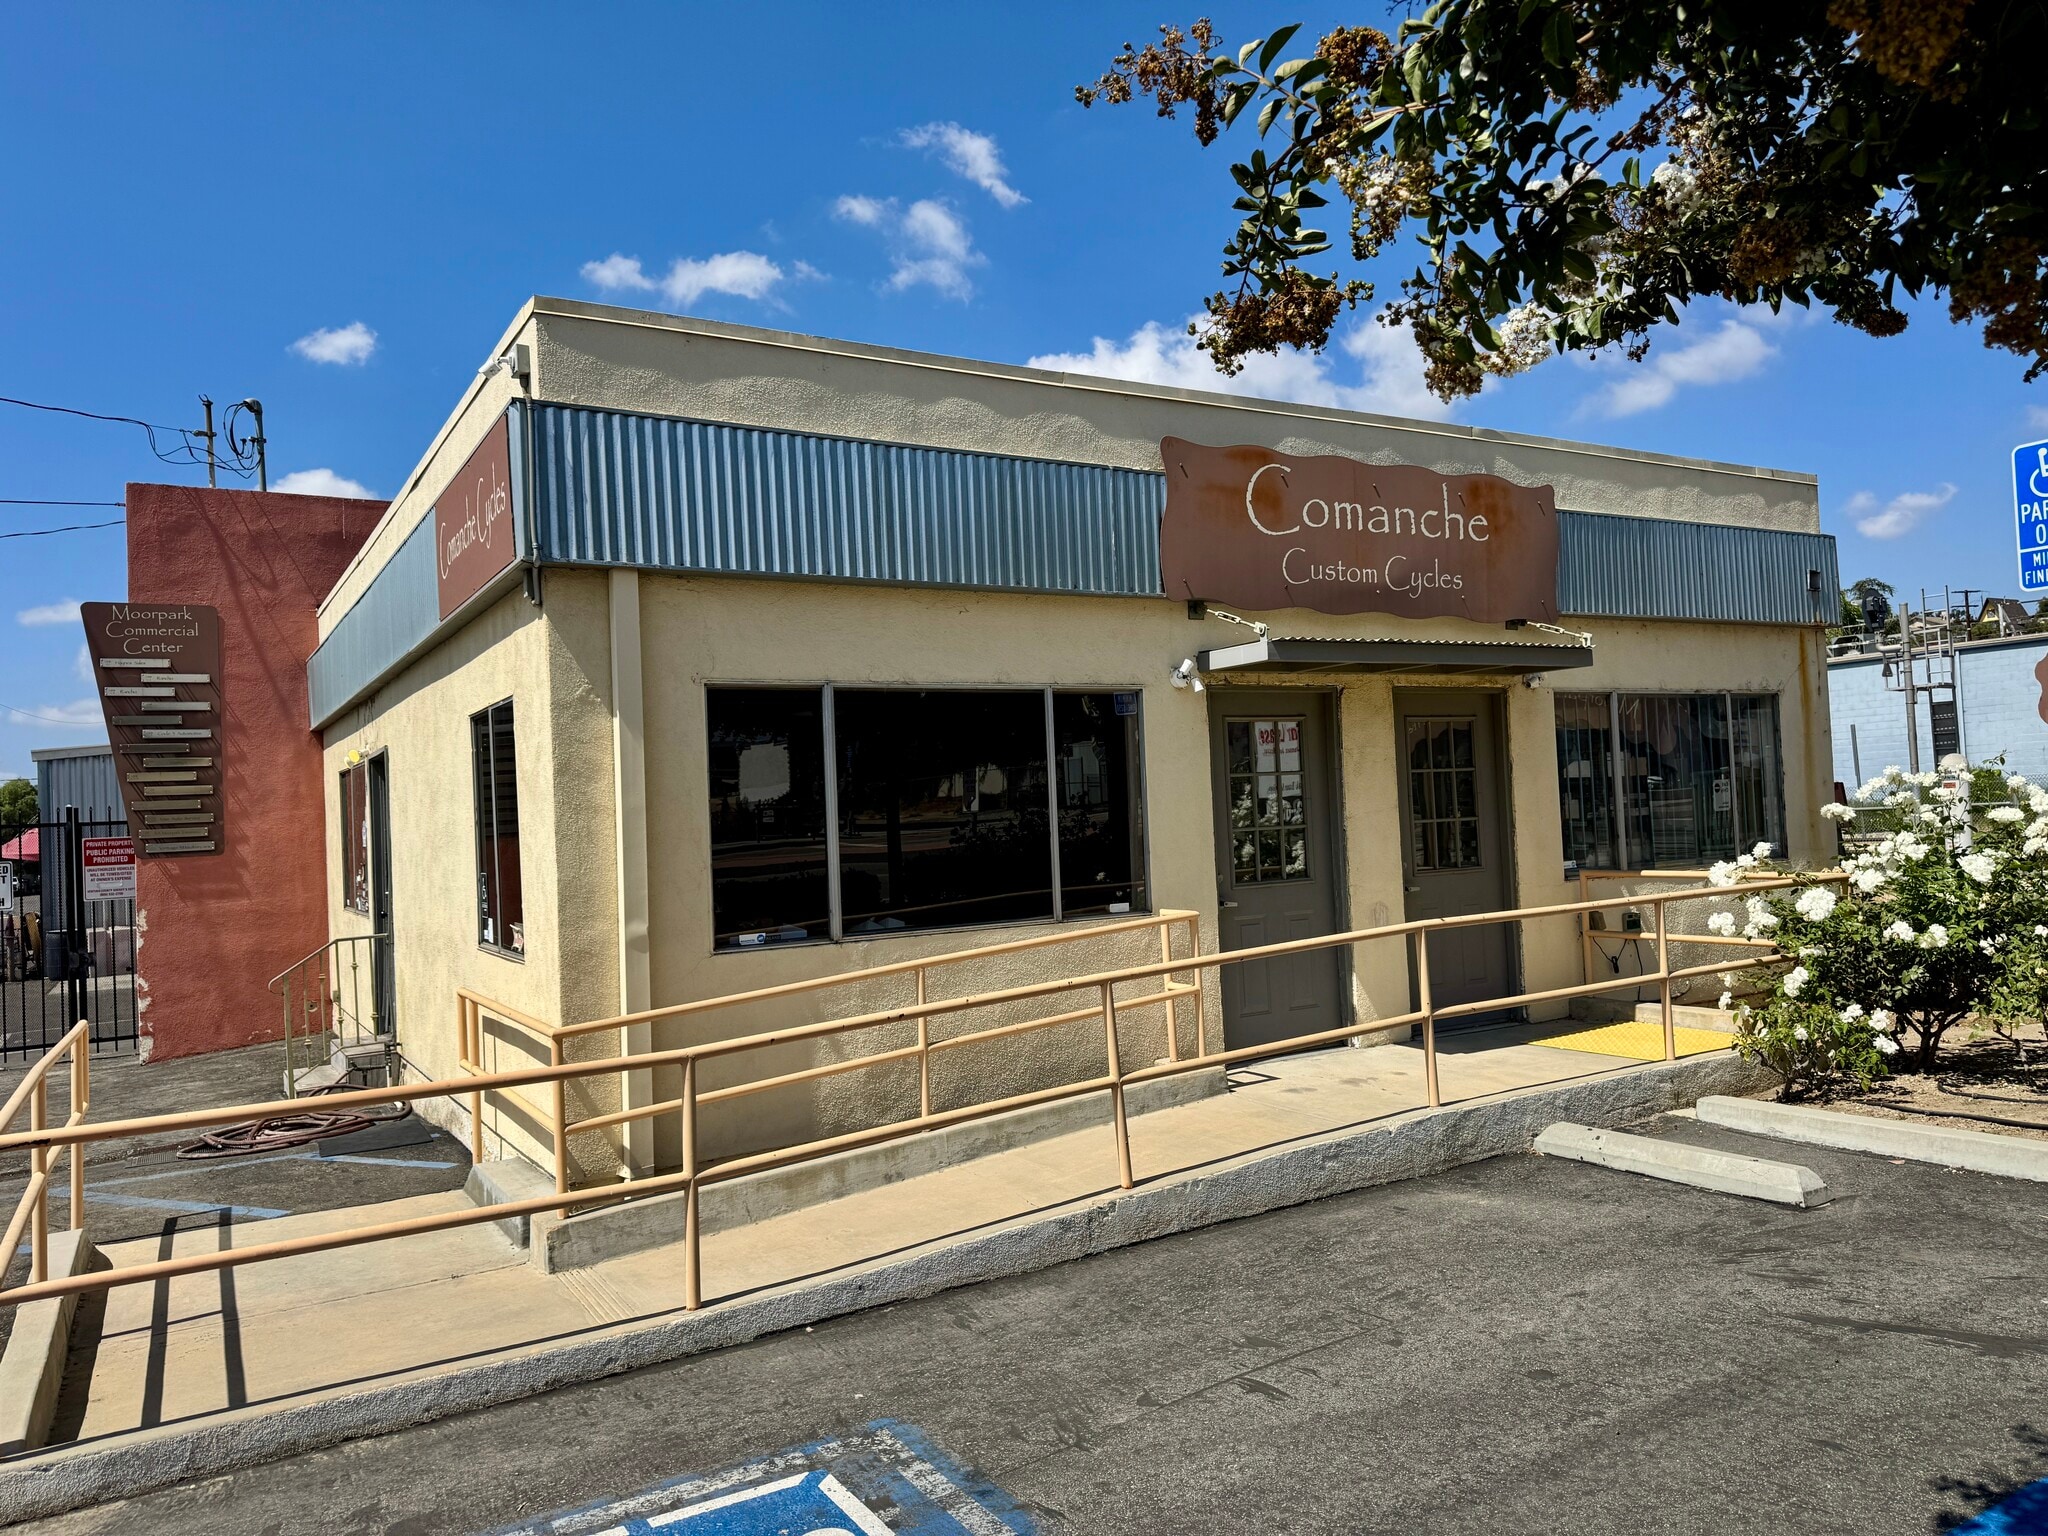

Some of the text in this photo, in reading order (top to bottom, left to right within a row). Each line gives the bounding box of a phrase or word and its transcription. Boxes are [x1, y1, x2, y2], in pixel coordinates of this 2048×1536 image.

[1246, 463, 1489, 542] Comanche
[439, 461, 506, 580] Comanche Cycles
[2033, 551, 2048, 567] MI
[1282, 547, 1463, 599] Custom Cycles
[111, 604, 192, 625] Moorpark
[105, 621, 199, 638] Commercial
[123, 638, 183, 655] Center
